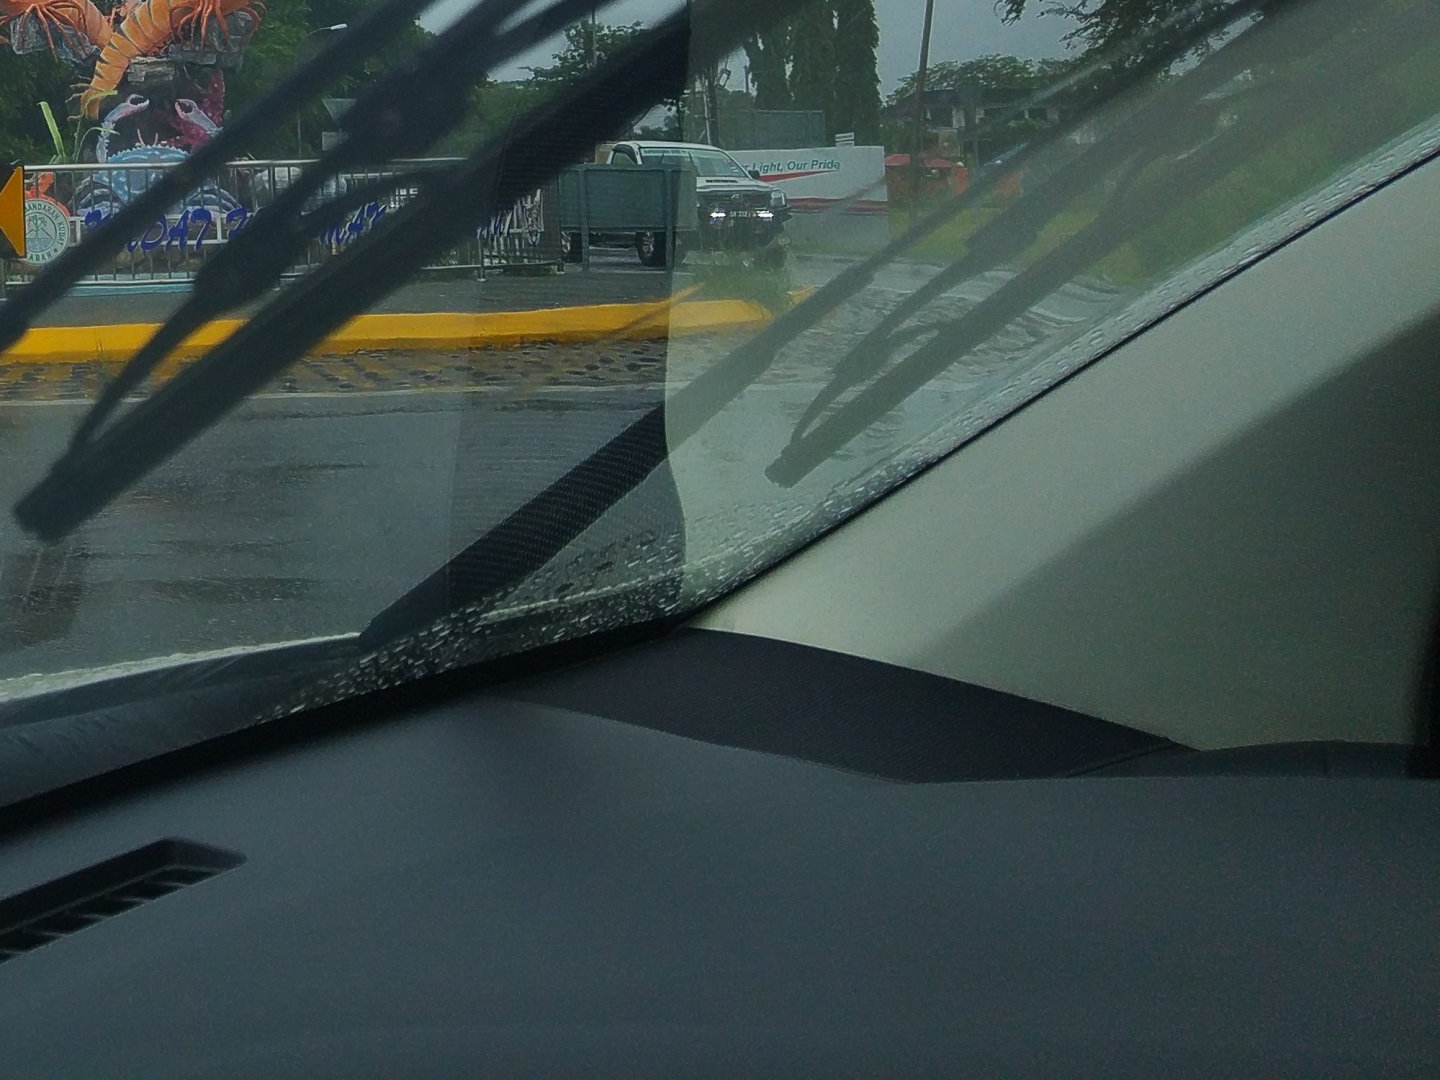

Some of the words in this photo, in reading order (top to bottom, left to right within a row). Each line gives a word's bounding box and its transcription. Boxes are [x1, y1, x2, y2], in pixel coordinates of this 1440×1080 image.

[786, 160, 808, 171] Our
[810, 159, 841, 170] Pride
[57, 221, 66, 246] KUDAT
